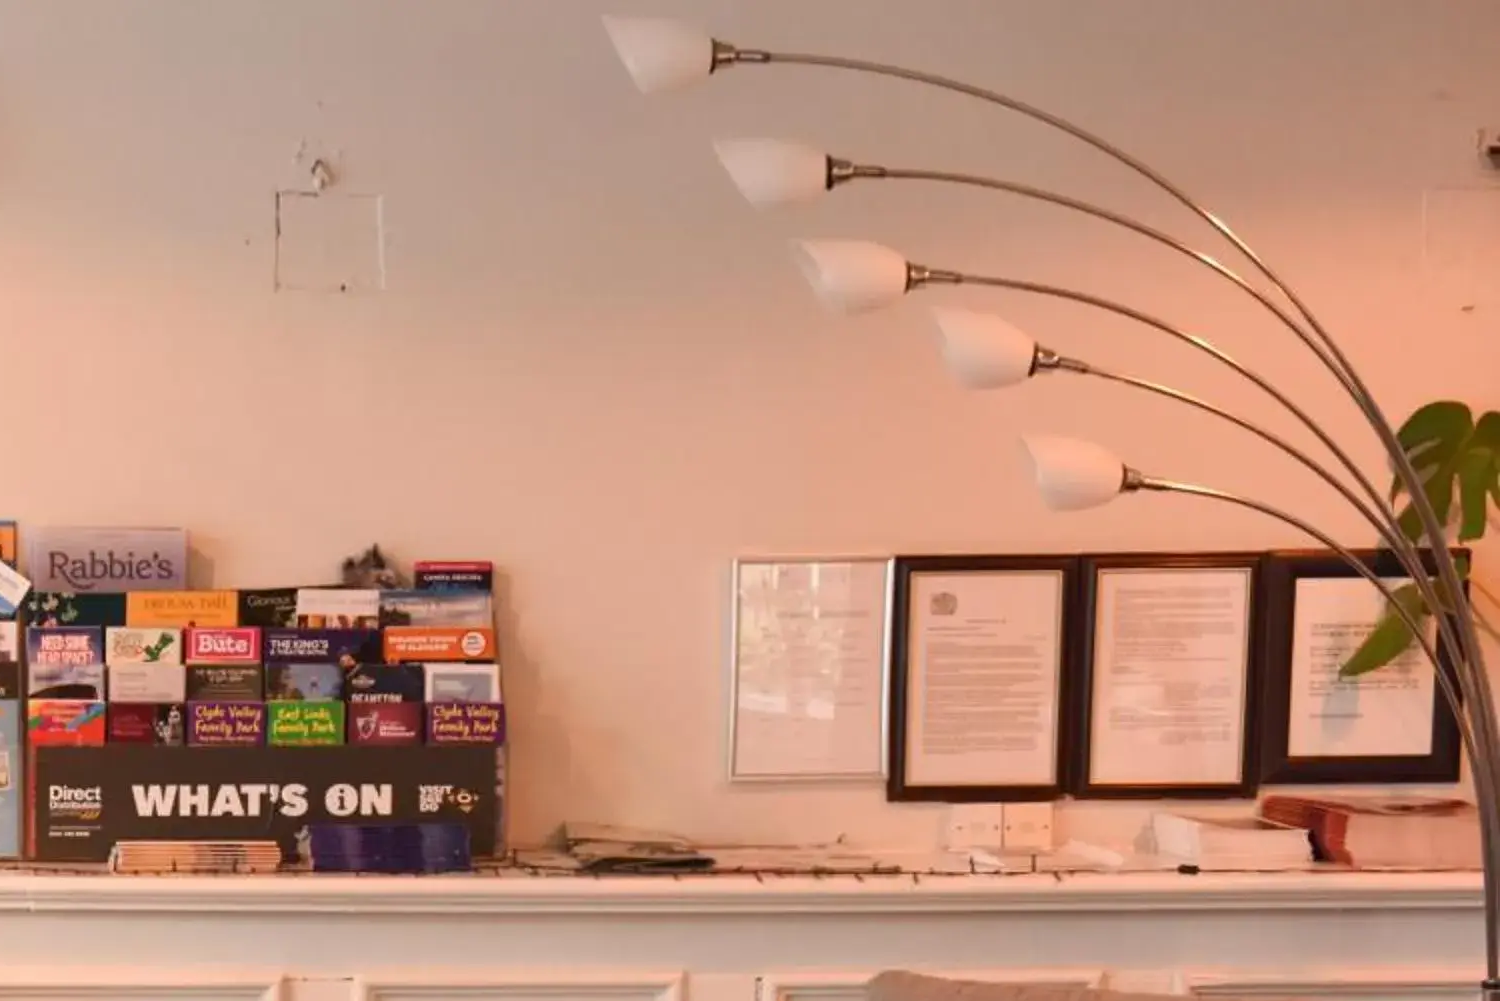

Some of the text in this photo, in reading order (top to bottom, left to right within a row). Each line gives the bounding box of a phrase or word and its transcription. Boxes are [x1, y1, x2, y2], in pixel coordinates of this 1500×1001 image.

[48, 550, 174, 590] Rabbie's
[199, 634, 248, 654] Bute
[195, 704, 261, 721] Clyde Valley
[433, 703, 500, 721] Clyde Valley
[195, 720, 260, 737] Family Park
[273, 719, 336, 737] Family Park
[433, 719, 498, 737] Family Park
[49, 784, 102, 801] Direct
[131, 783, 393, 817] WHAT'S ON
